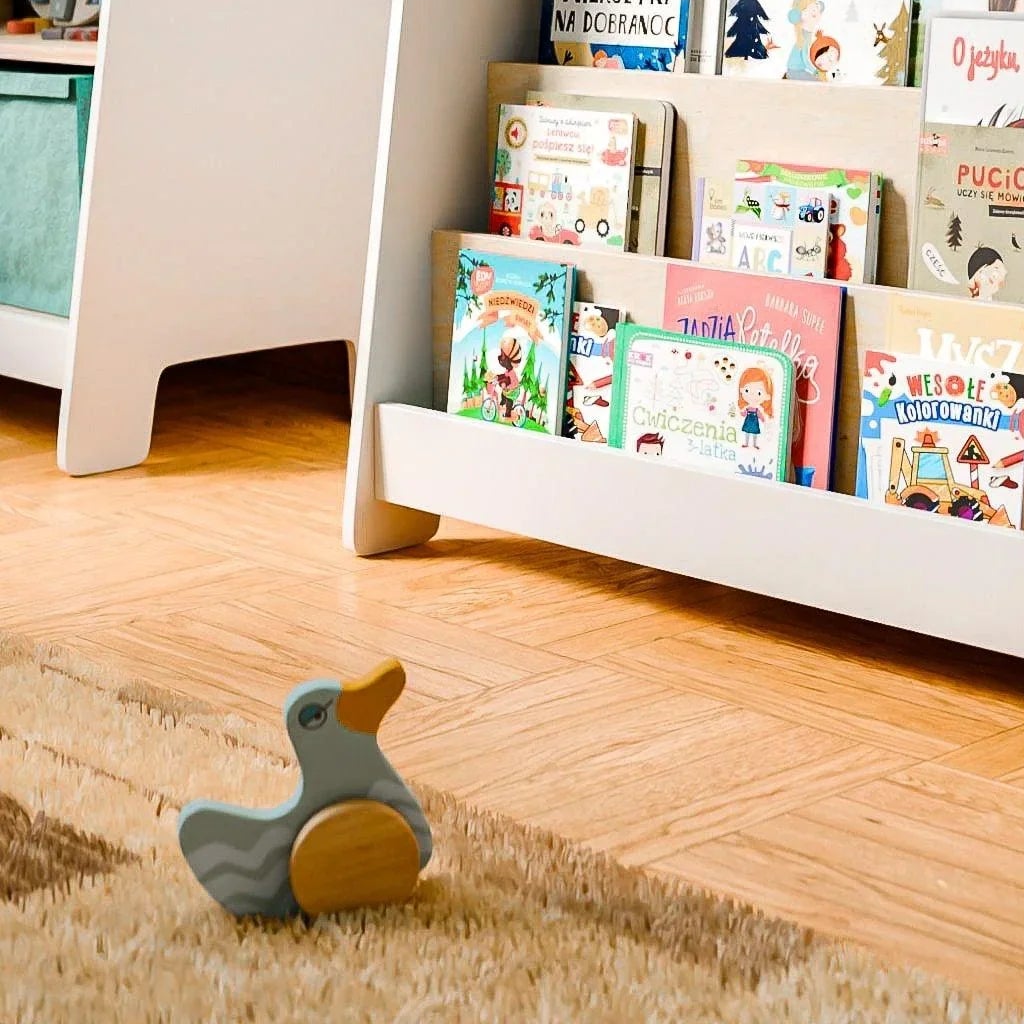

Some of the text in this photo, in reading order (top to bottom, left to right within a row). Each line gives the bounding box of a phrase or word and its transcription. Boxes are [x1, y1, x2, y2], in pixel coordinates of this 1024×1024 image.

[555, 10, 676, 36] NA DOBRANOC
[953, 36, 966, 66] O
[967, 39, 1020, 81] jeżyku,
[957, 189, 978, 198] UCZY
[906, 373, 986, 403] WESOŁE
[895, 400, 1002, 431] Kolorowanki
